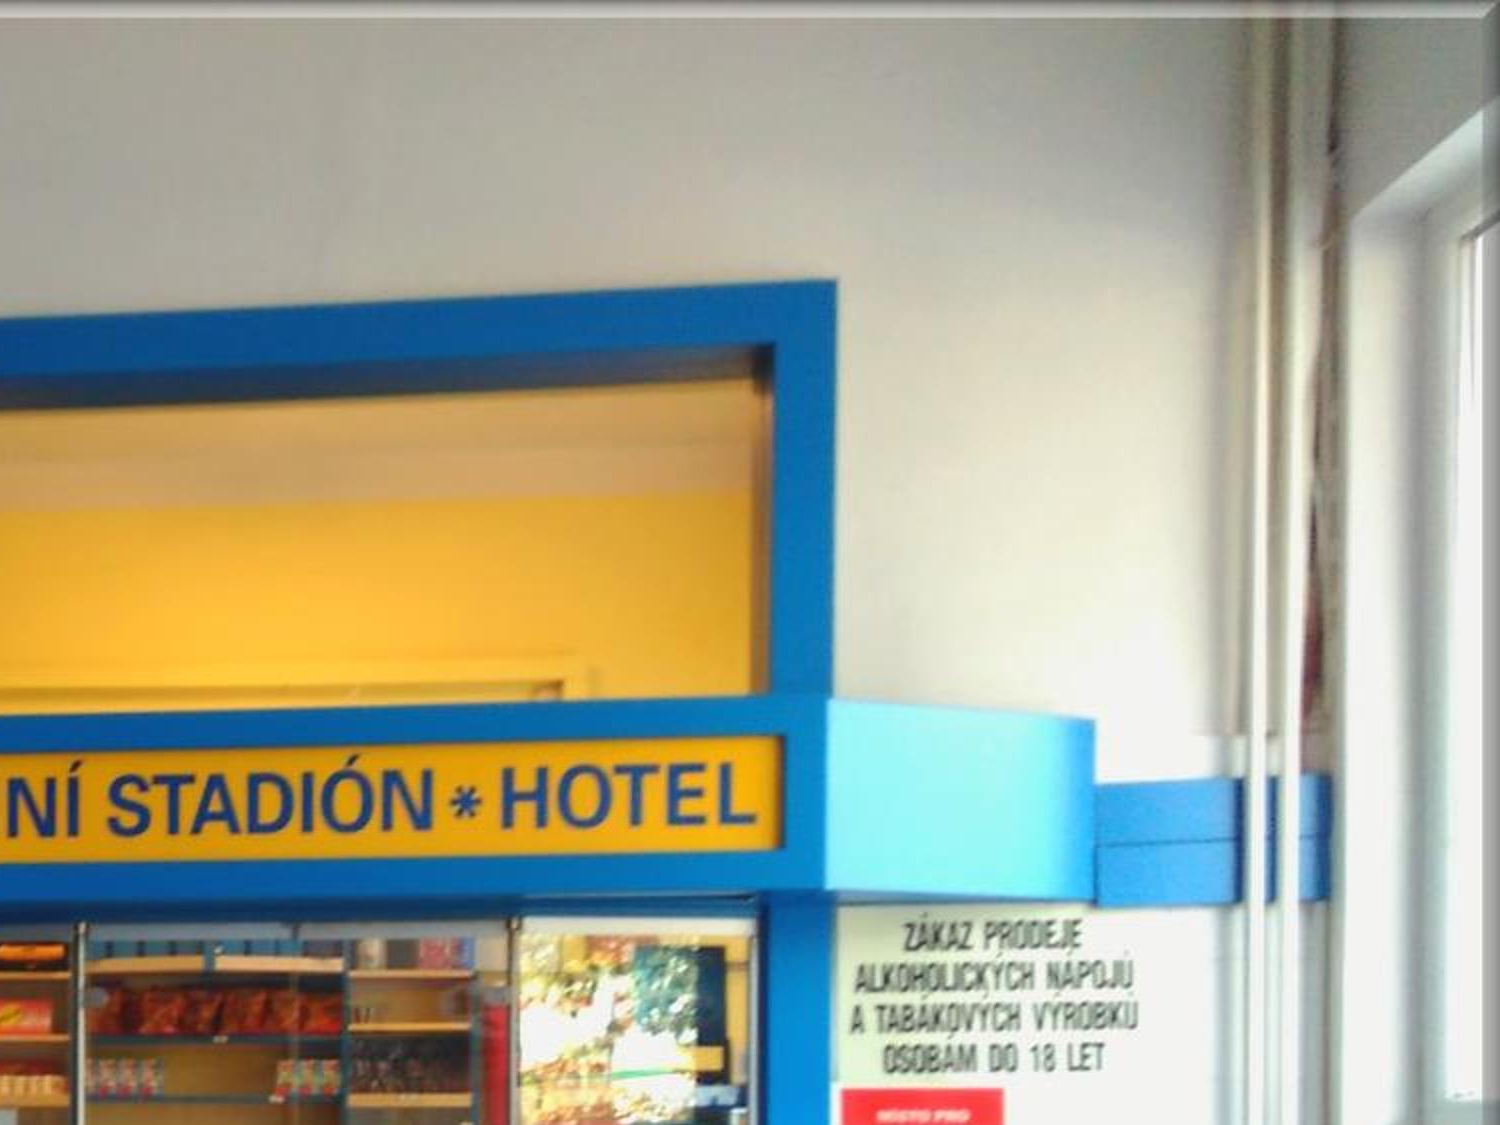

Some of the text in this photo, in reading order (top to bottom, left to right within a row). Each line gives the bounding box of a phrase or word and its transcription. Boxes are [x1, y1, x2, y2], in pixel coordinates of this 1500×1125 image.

[106, 754, 434, 838] STADIÓN
[499, 761, 758, 830] HOTEL
[903, 911, 1083, 951] ZÁKAZ PRODEJE
[854, 951, 1035, 993] ALKOHOLICKÝCH
[850, 1004, 866, 1034] A
[874, 993, 1022, 1033] TABÁKOVÝCH
[882, 1032, 1106, 1074] OSOBÁM DO 18 LET
